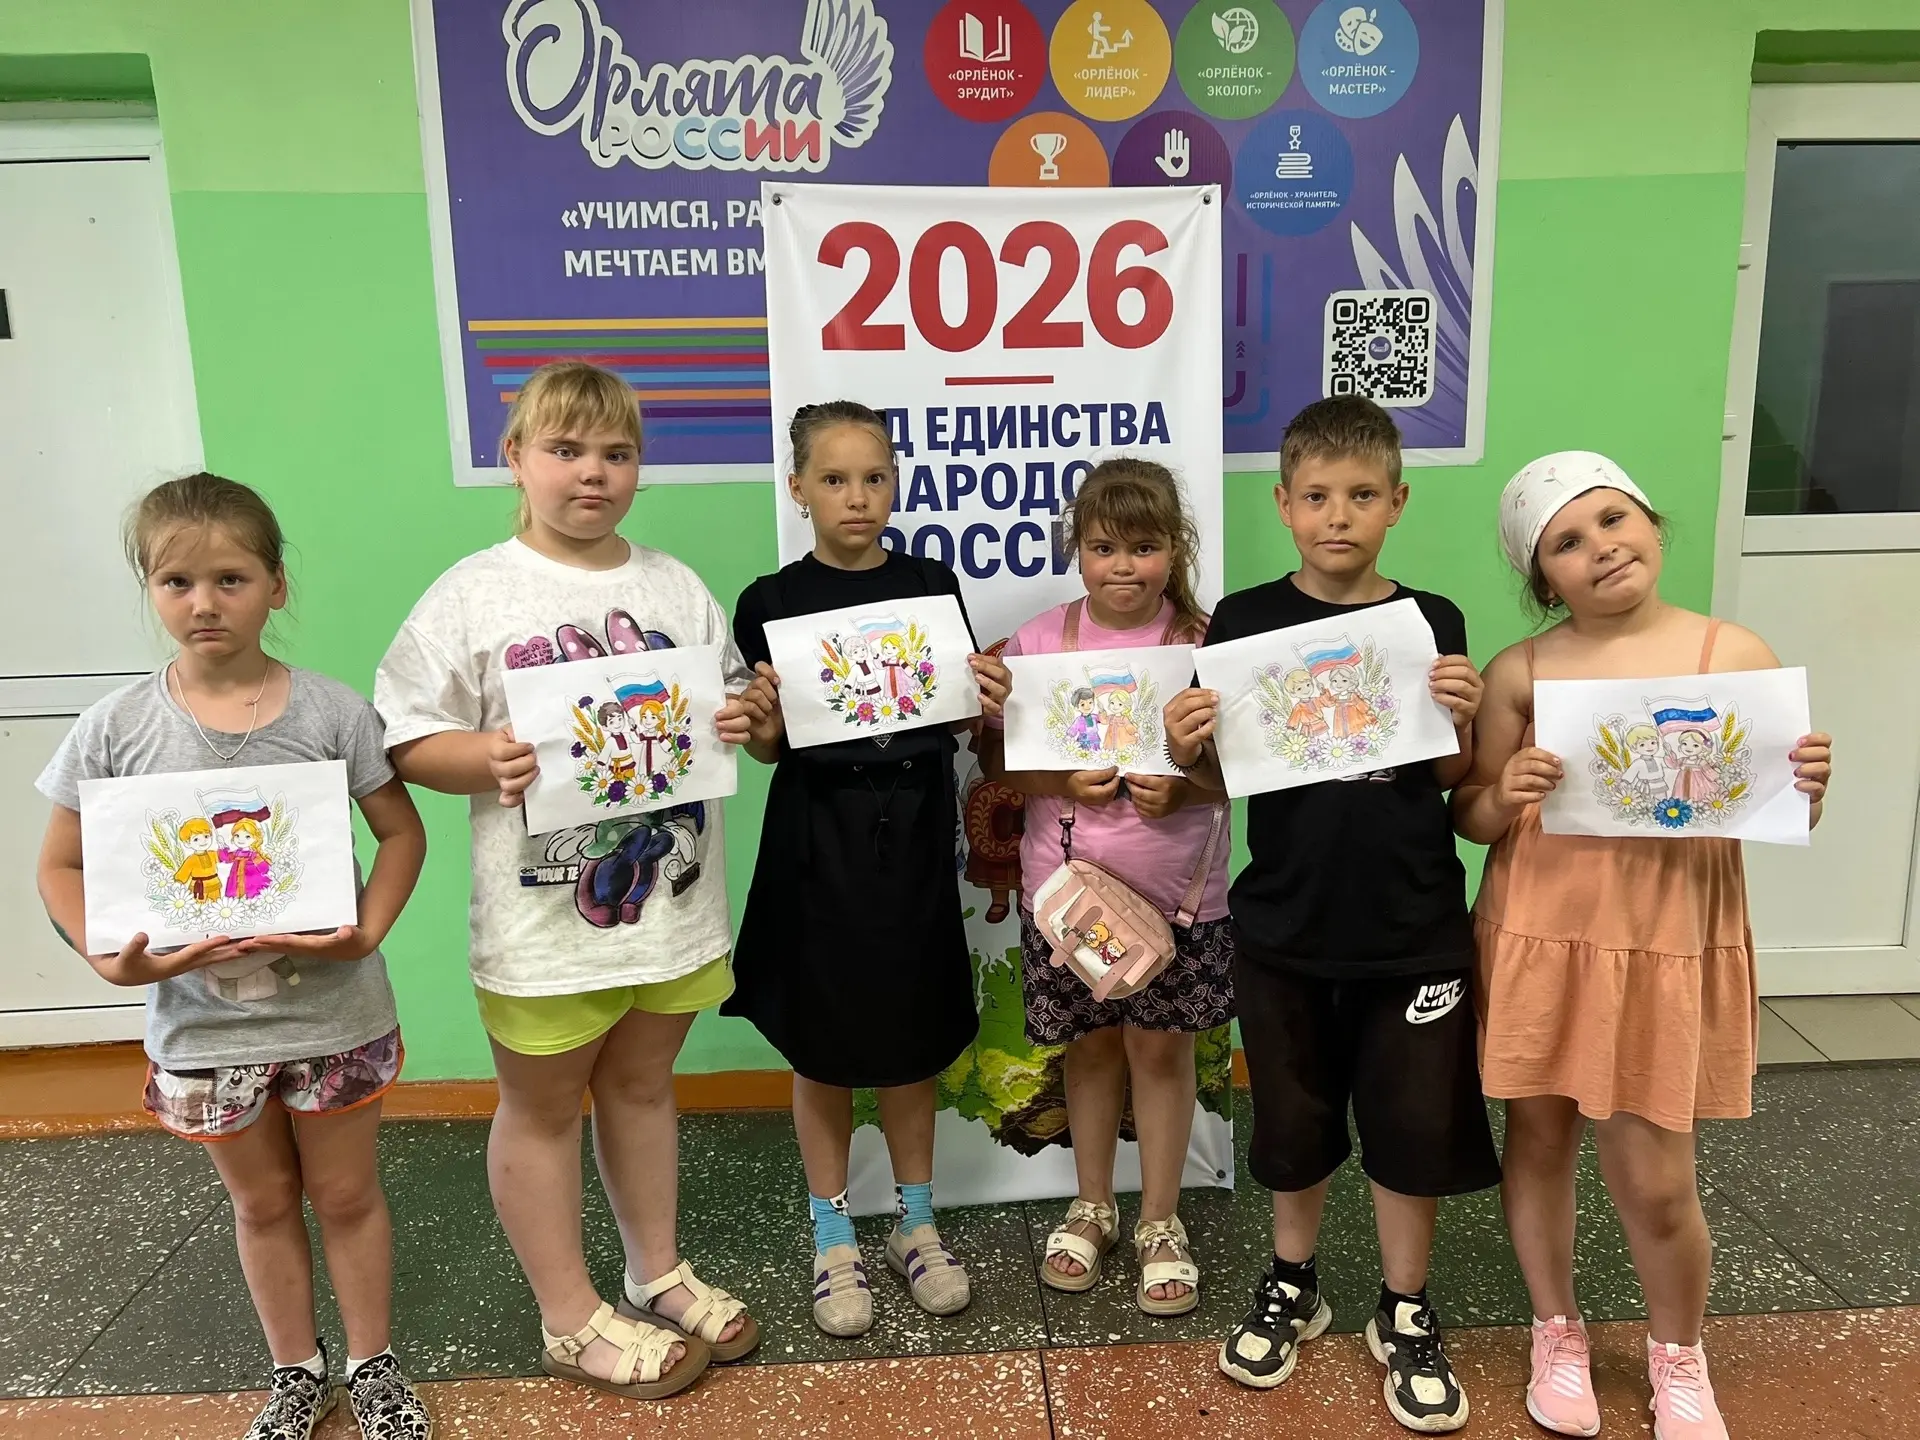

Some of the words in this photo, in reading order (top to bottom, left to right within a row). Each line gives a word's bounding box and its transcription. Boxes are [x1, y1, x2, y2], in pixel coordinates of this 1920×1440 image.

[512, 0, 823, 142] Орлята
[948, 67, 1015, 80] «ОРЛЁНОК
[1074, 66, 1140, 80] «ОРЛЁНОК
[1197, 65, 1264, 79] «ОРЛЁНОК
[1321, 63, 1387, 77] «ОРЛЁНОК
[957, 87, 1014, 100] ЭРУДИТ»
[1084, 86, 1136, 99] ЛИДЕР»
[1207, 85, 1262, 96] ЭКОЛОГ»
[1329, 83, 1386, 95] МАСТЕР»
[599, 115, 821, 163] РОССИИ
[1294, 191, 1338, 199] ХРАНИТЕЛЬ
[1246, 200, 1304, 209] ИСТОРИЧЕСКОЙ
[561, 200, 719, 231] «УЧИМСЯ,
[564, 248, 718, 277] МЕЧТАЕМ
[817, 219, 1174, 352] 2026
[926, 401, 1171, 457] ЕДИНСТВА
[1415, 979, 1461, 1008] NIKE
